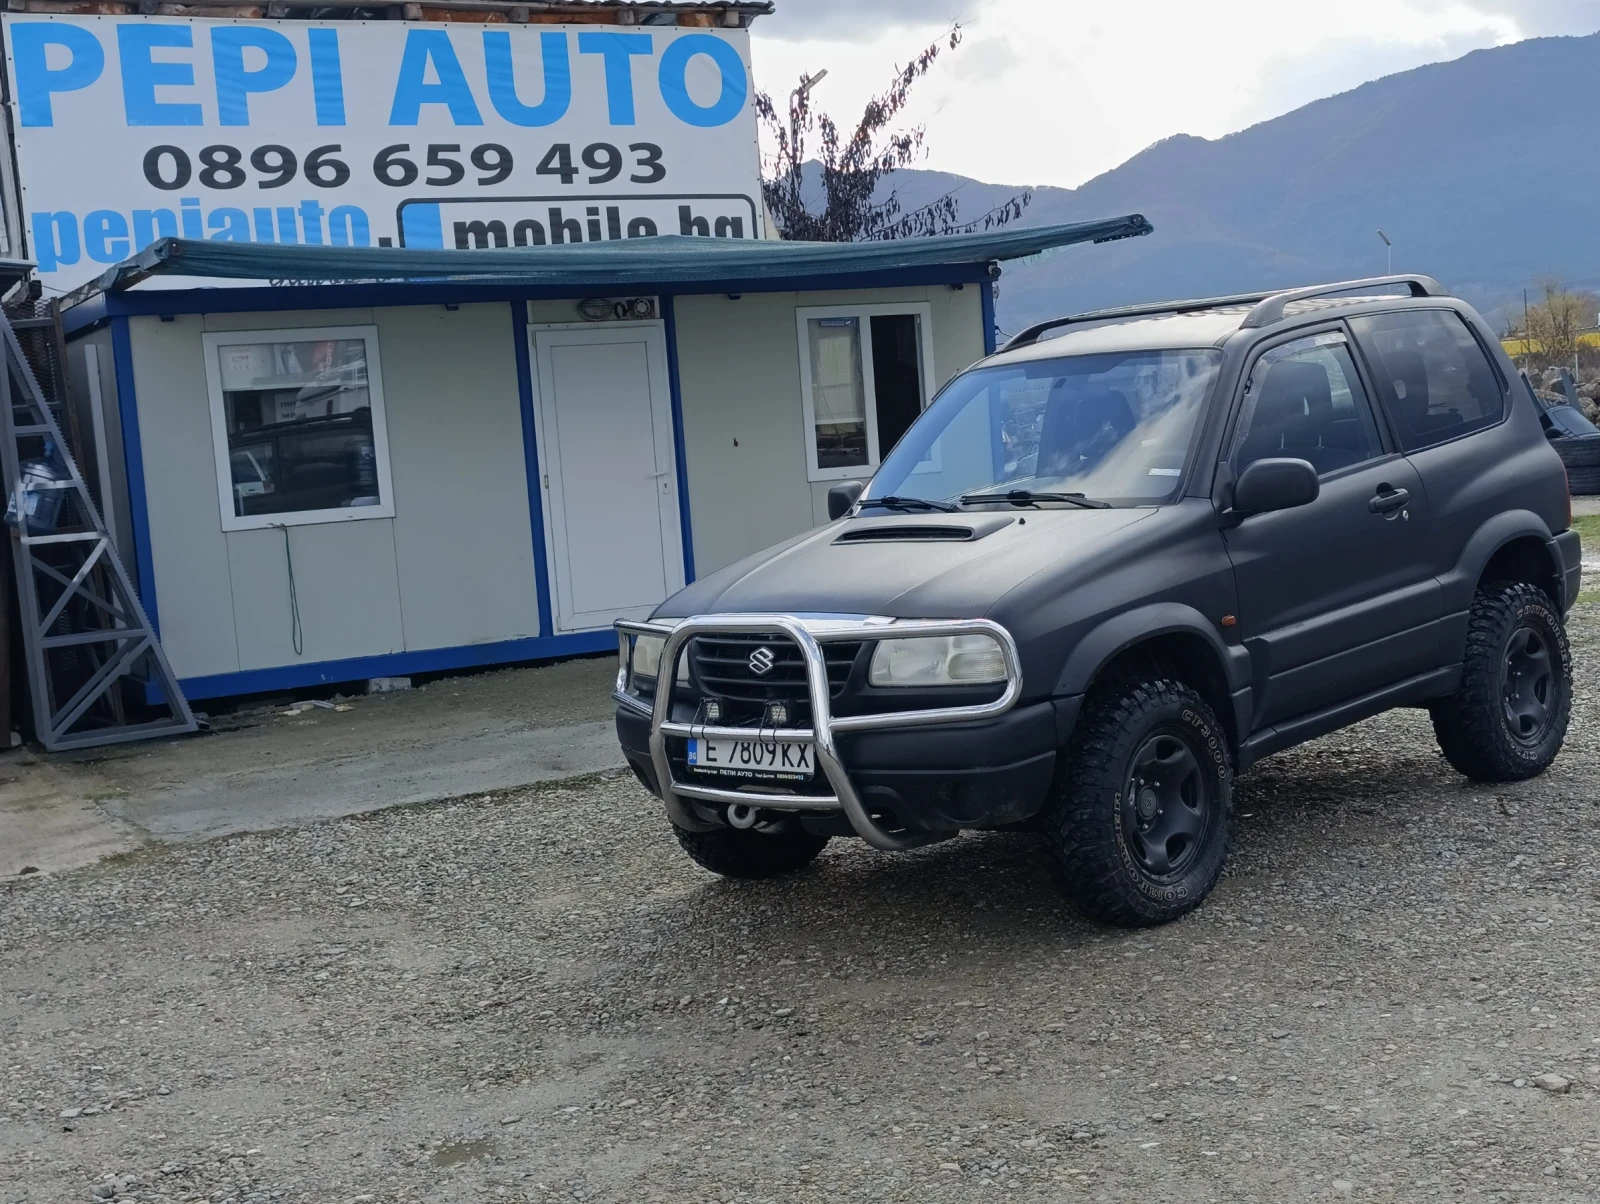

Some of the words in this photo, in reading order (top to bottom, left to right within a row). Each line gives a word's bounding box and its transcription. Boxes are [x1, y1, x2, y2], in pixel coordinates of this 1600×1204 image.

[10, 22, 346, 128] PEPI
[388, 29, 748, 128] AUTO
[143, 144, 350, 190] 0896
[373, 143, 514, 188] 659
[536, 142, 667, 185] 493
[1181, 709, 1227, 779] CF3000
